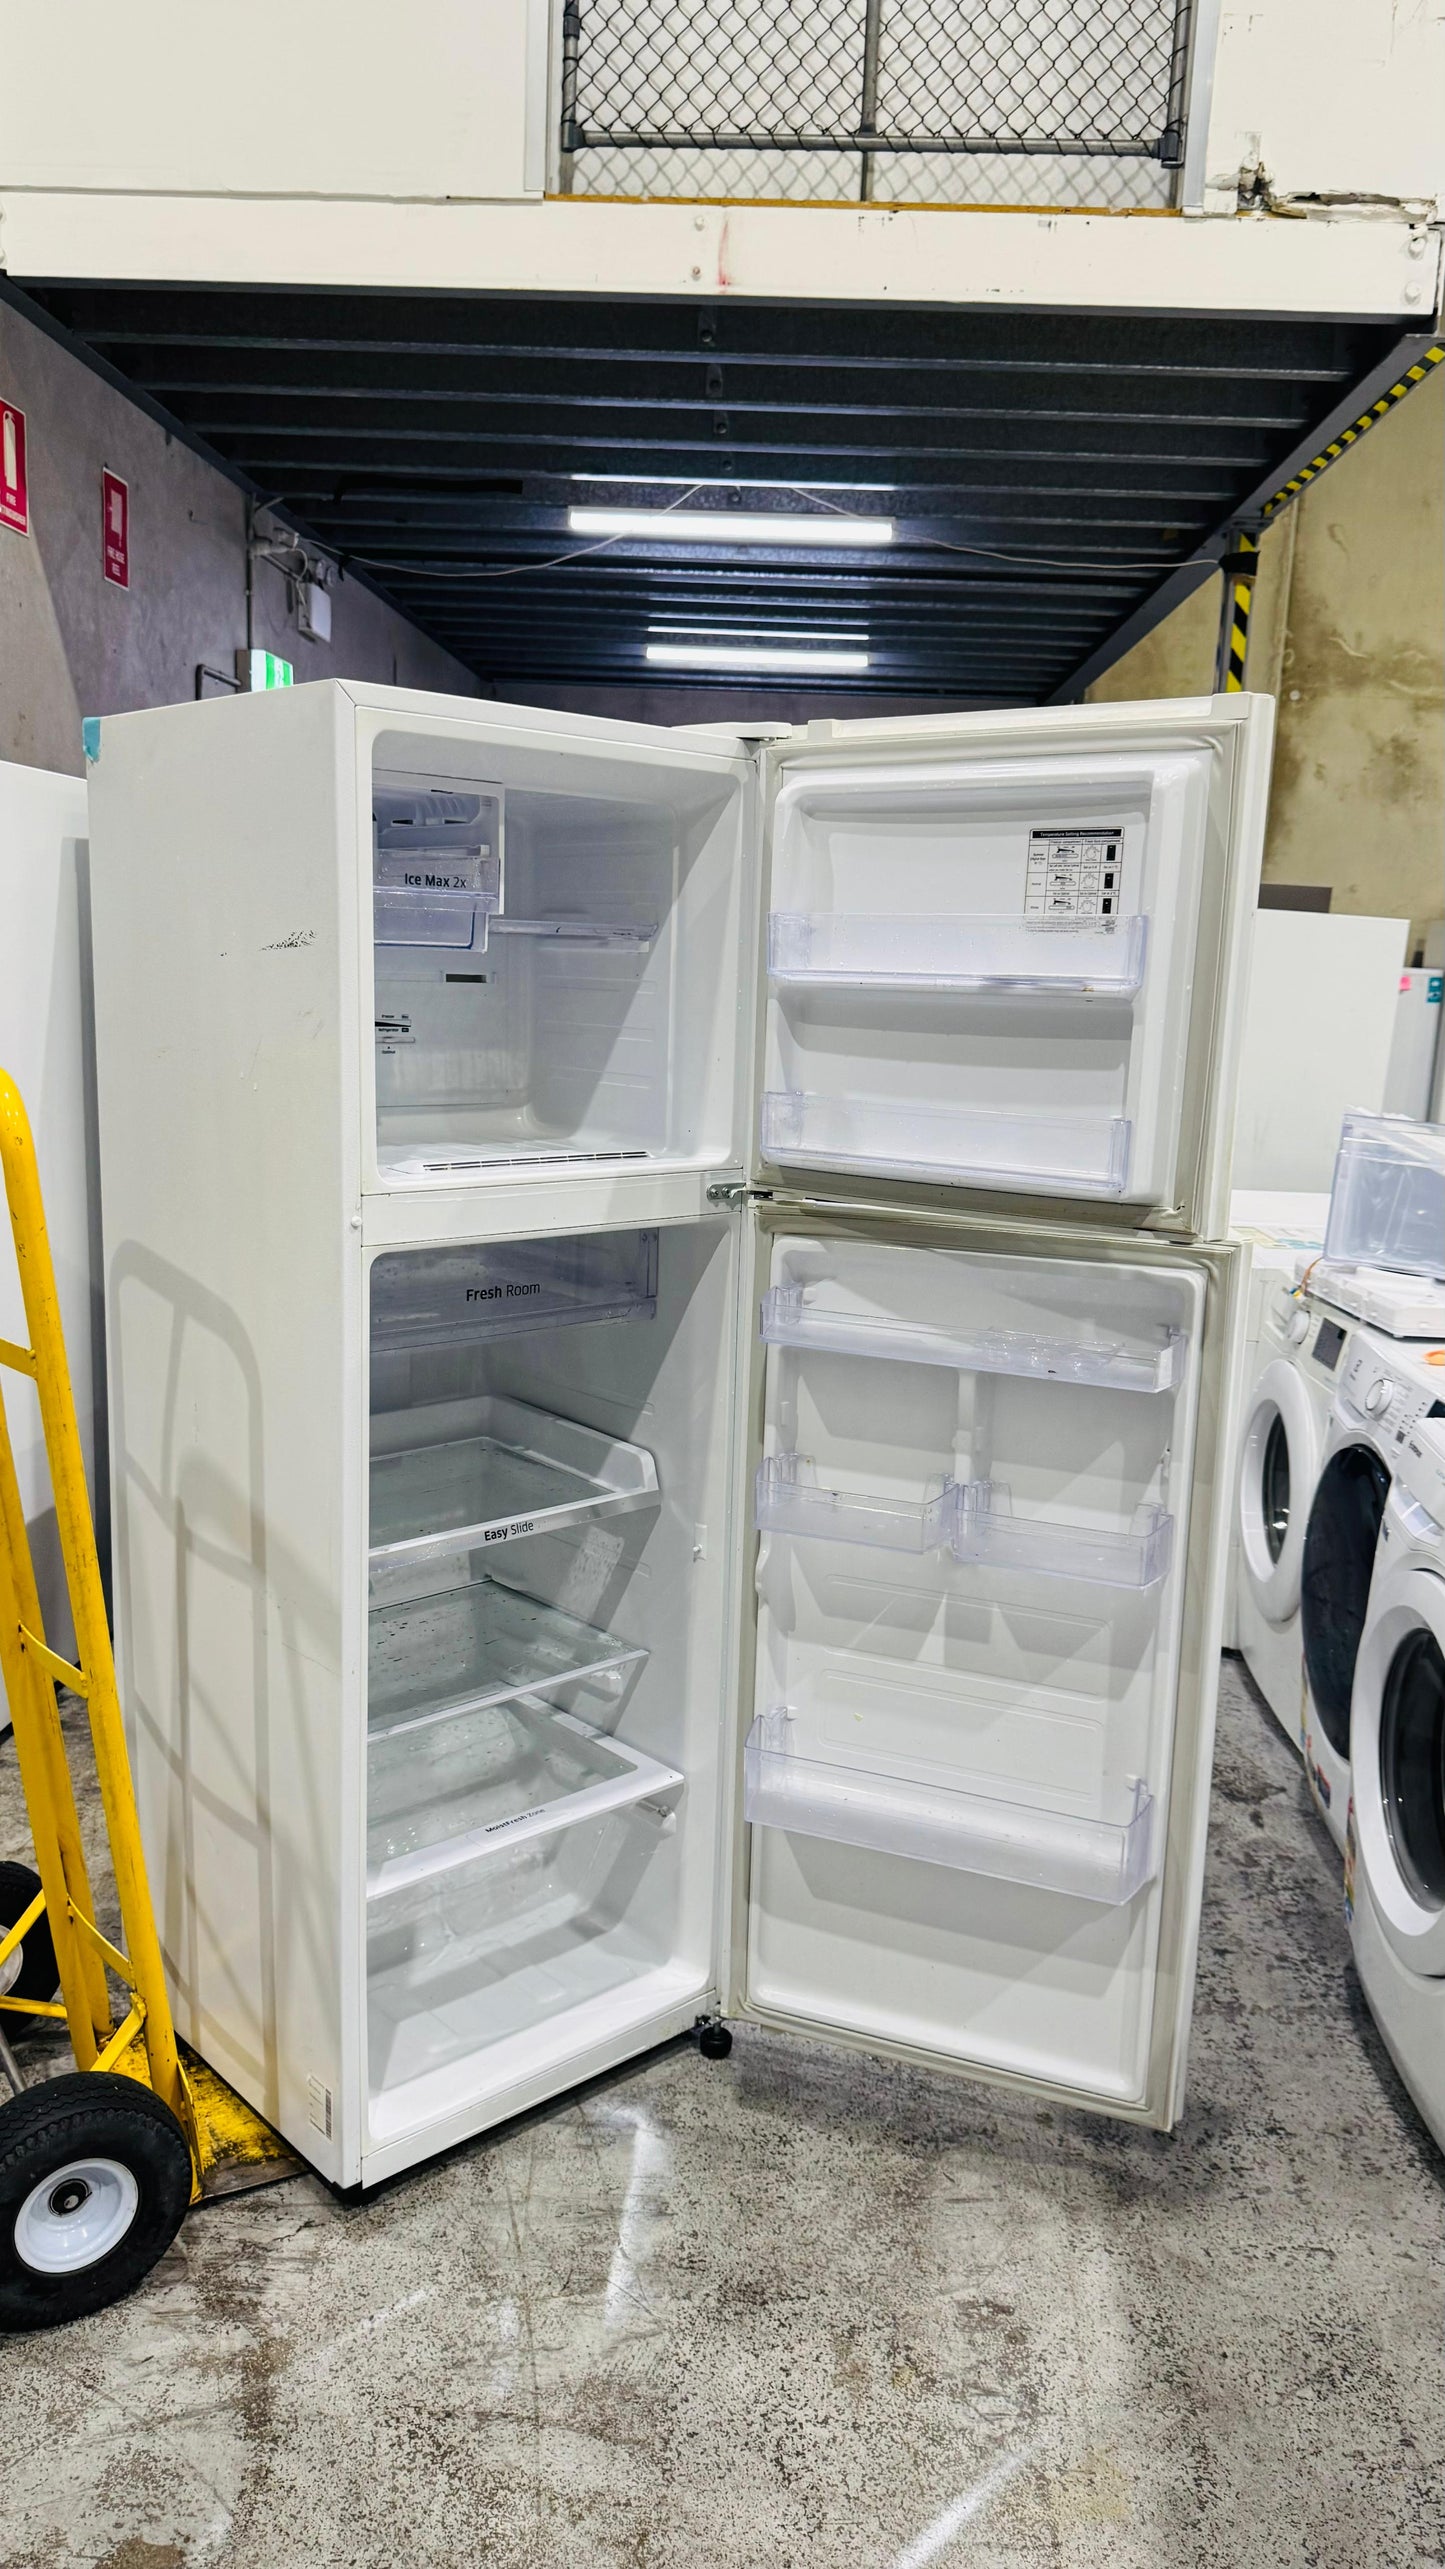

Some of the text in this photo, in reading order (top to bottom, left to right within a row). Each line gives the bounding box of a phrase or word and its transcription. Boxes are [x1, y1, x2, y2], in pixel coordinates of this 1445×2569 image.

[404, 873, 467, 889] Ice Max 2x
[466, 1283, 540, 1302] Fresh Room
[484, 1521, 534, 1541] Easy Slide
